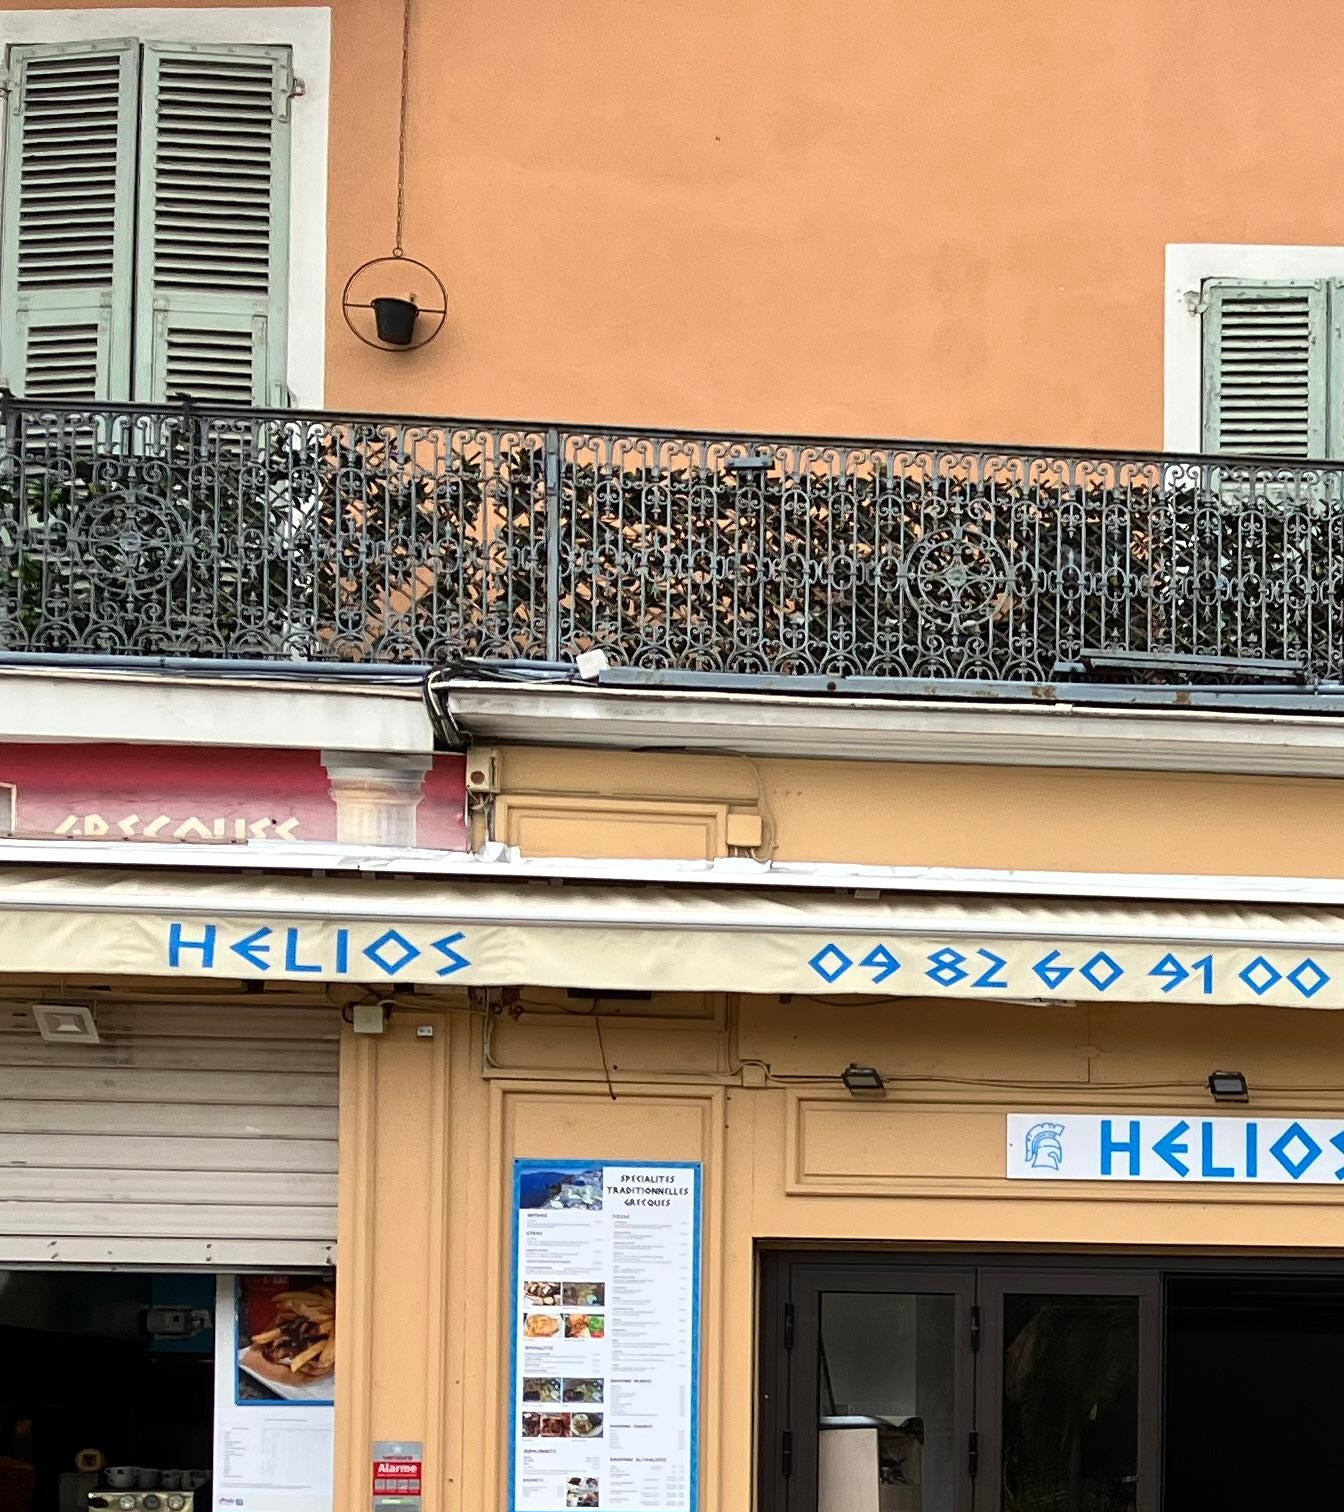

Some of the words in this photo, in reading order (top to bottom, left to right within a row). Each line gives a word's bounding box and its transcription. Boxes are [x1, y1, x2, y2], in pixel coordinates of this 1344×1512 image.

[167, 922, 473, 978] HELIOS
[808, 942, 902, 985] 09
[924, 946, 1009, 989] 82
[1032, 950, 1125, 993] 60
[1147, 953, 1214, 996] 91
[1238, 955, 1331, 1000] 00
[620, 1175, 675, 1184] SPECIALITES
[606, 1186, 689, 1196] TRADITIONNELLES
[624, 1198, 671, 1208] GRECQUES
[377, 1463, 418, 1473] Alarme
